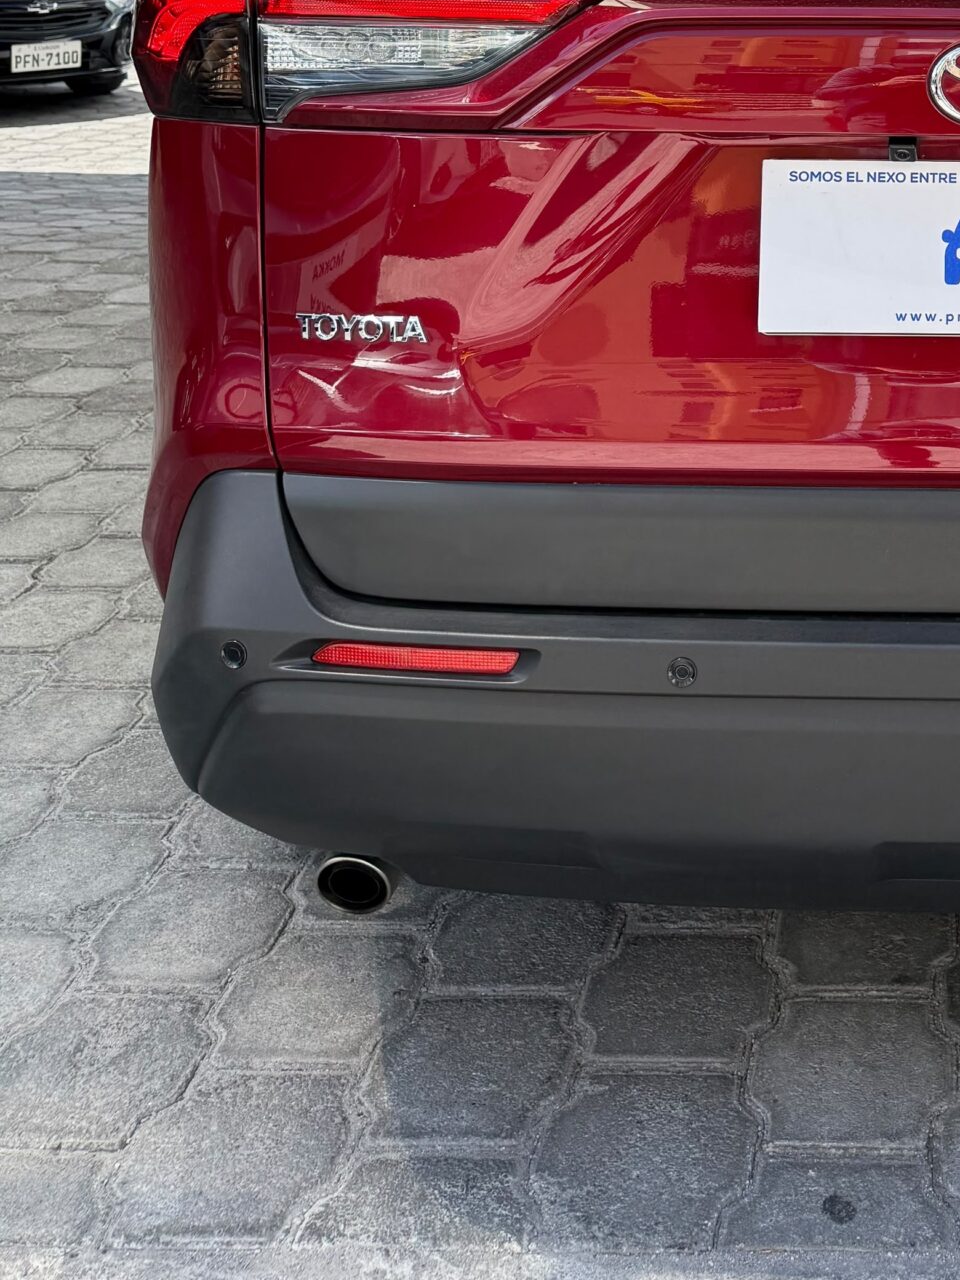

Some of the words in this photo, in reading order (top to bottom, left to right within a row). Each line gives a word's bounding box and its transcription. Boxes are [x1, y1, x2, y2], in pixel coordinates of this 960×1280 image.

[15, 51, 78, 68] PFN-7100
[789, 170, 843, 183] SOMOS
[846, 171, 864, 183] EL
[866, 171, 907, 184] NEXO
[910, 172, 957, 184] ENTRE
[295, 312, 428, 343] TOYOTA
